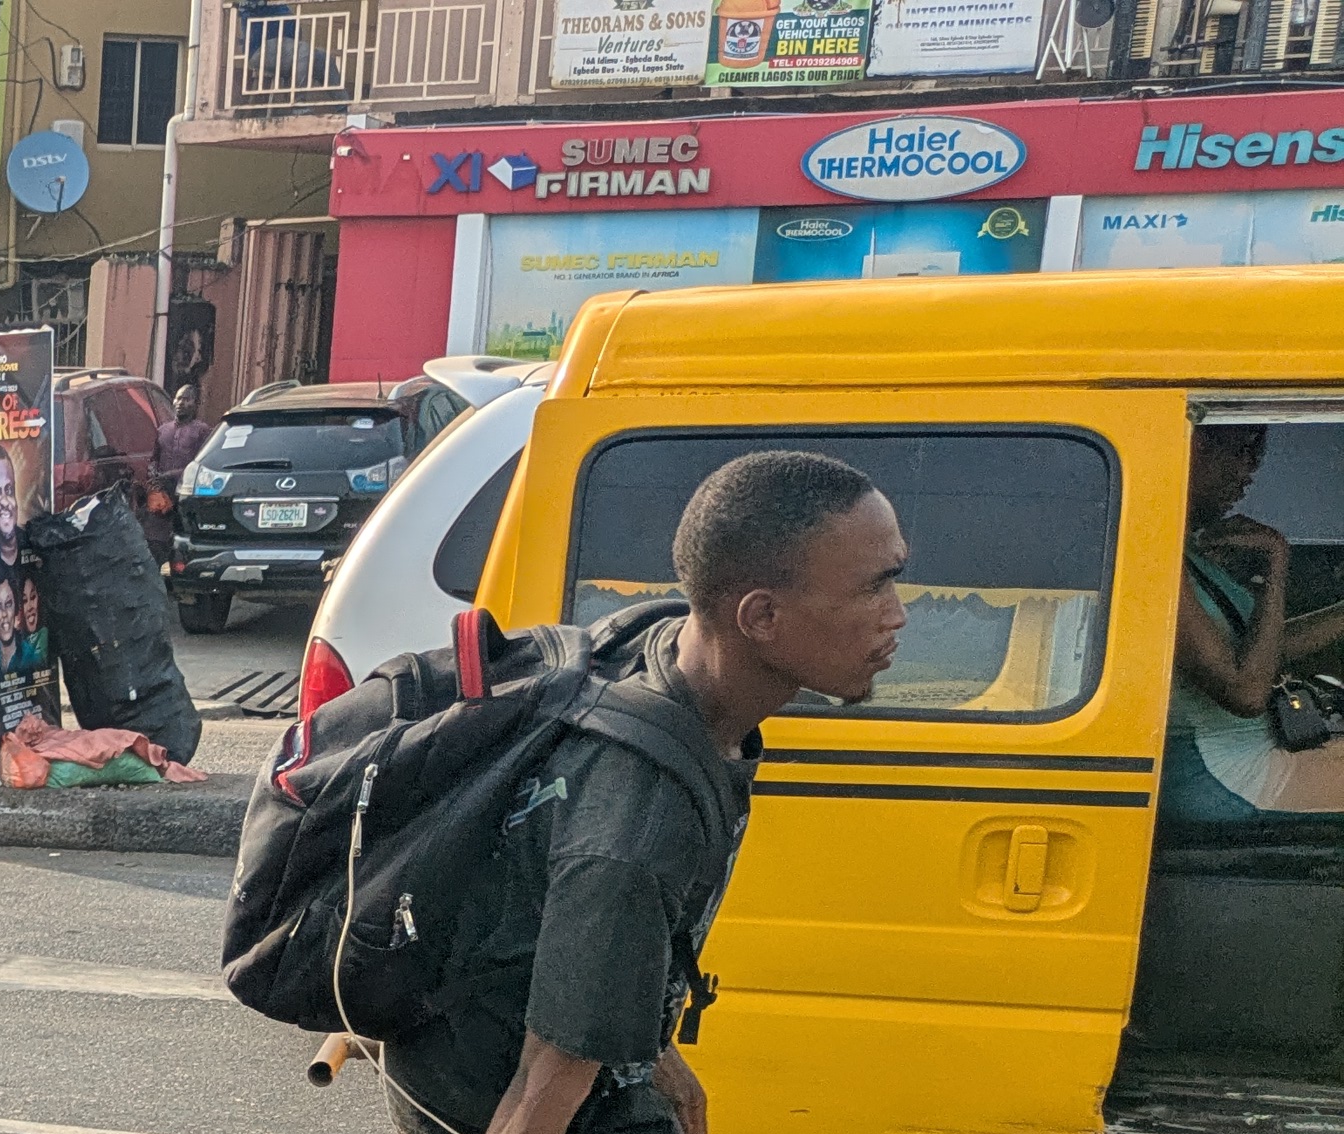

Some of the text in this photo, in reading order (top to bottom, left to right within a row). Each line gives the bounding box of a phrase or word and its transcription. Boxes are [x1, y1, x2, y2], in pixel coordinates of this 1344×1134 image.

[562, 11, 706, 34] THEORAMS & SONS
[776, 17, 865, 30] GET YOUR LAGOS
[778, 28, 860, 40] VEHICLE LITTER
[597, 34, 664, 54] Ventures
[776, 39, 808, 56] BIN
[812, 38, 860, 55] HERE
[582, 56, 596, 65] 16A
[597, 55, 618, 64] Idimu
[625, 54, 653, 64] Egbeda
[773, 56, 859, 68] TEL: 07039284905
[573, 66, 600, 76] Egbeda
[601, 65, 615, 74] Bus
[642, 64, 664, 74] Lagos
[665, 62, 685, 71] State
[718, 69, 860, 83] CLEANER LAGOS IS OUR PRIDE
[867, 125, 962, 155] Haier
[562, 134, 699, 167] SUMEC
[817, 149, 1009, 181] THERMOCOOL
[534, 167, 711, 199] FIRMAN
[800, 219, 830, 230] Haier
[1102, 213, 1167, 230] MAXI
[785, 227, 844, 238] THERMOCOOL
[520, 250, 720, 273] SUMEC FIRMAN
[573, 272, 615, 280] GENERATOR
[616, 271, 640, 279] BRAND
[641, 271, 651, 279] IN
[651, 270, 680, 279] AFRICA
[1, 392, 19, 412] OF
